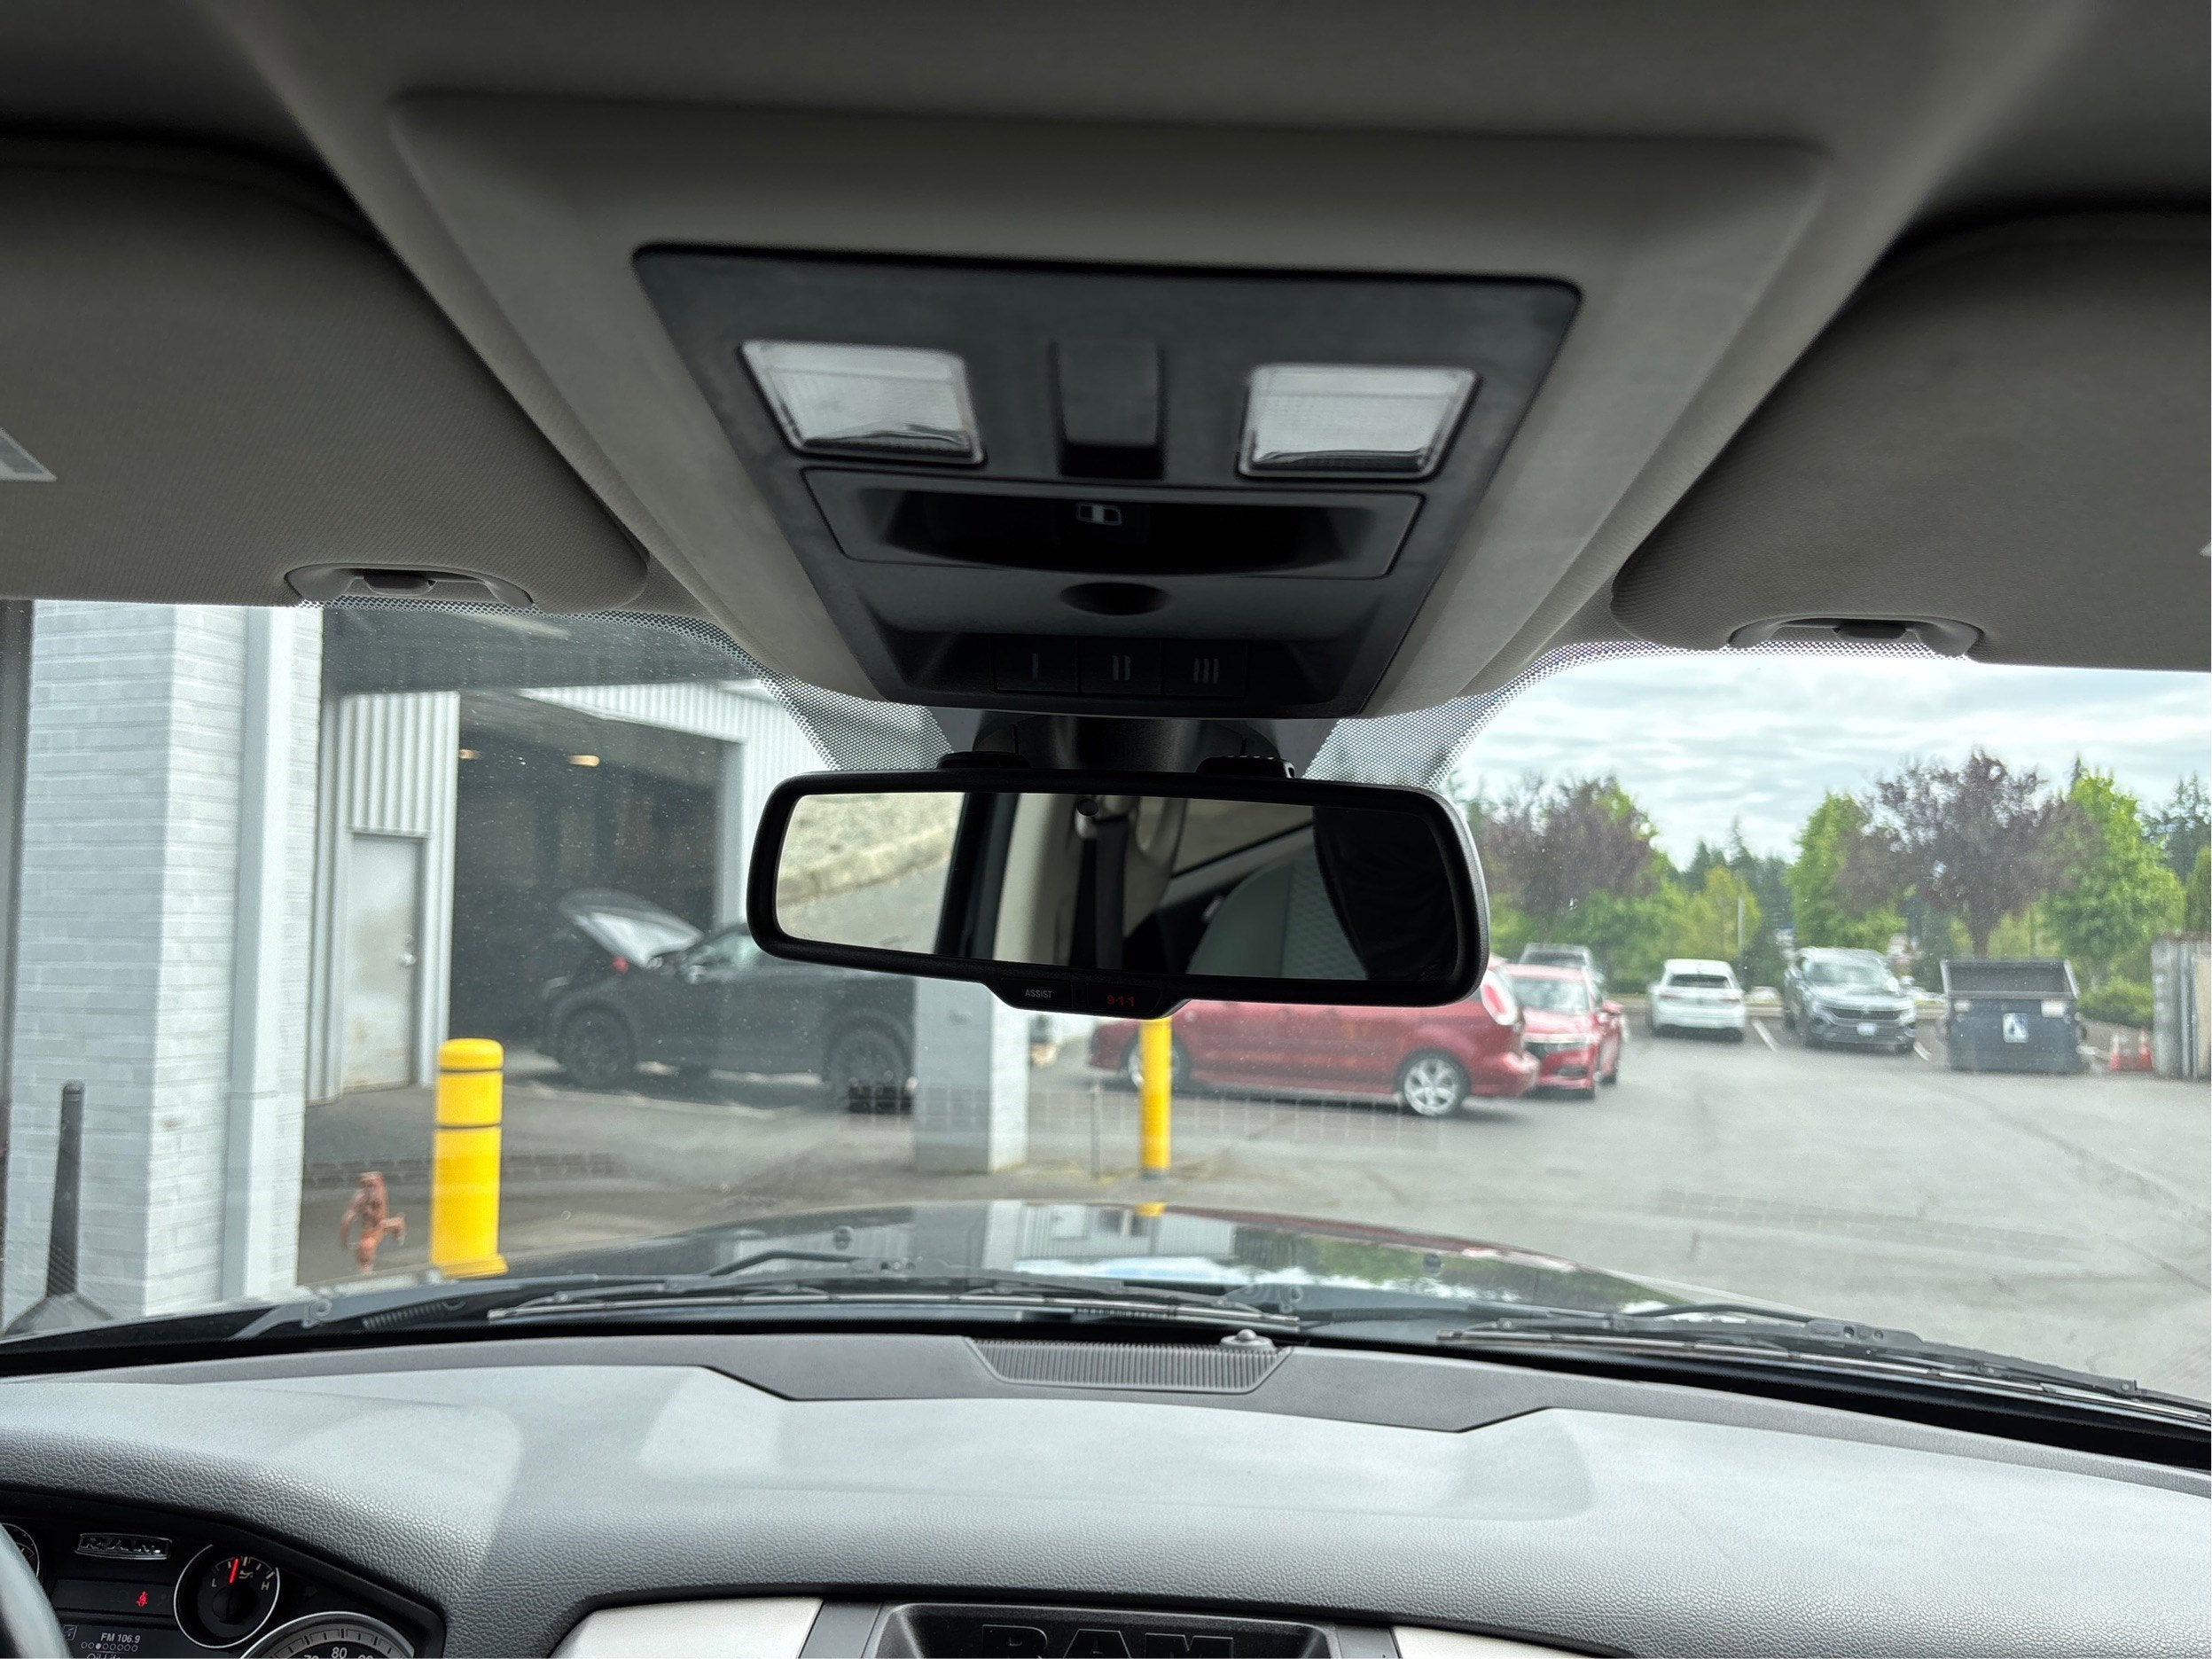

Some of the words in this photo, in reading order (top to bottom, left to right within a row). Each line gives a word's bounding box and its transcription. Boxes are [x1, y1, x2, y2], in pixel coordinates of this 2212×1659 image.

[1025, 988, 1052, 999] ASSIST
[261, 1581, 270, 1591] H
[100, 1632, 115, 1641] FM
[117, 1633, 141, 1644] 106.9
[982, 1624, 1234, 1658] RAM
[332, 1647, 348, 1658] 80
